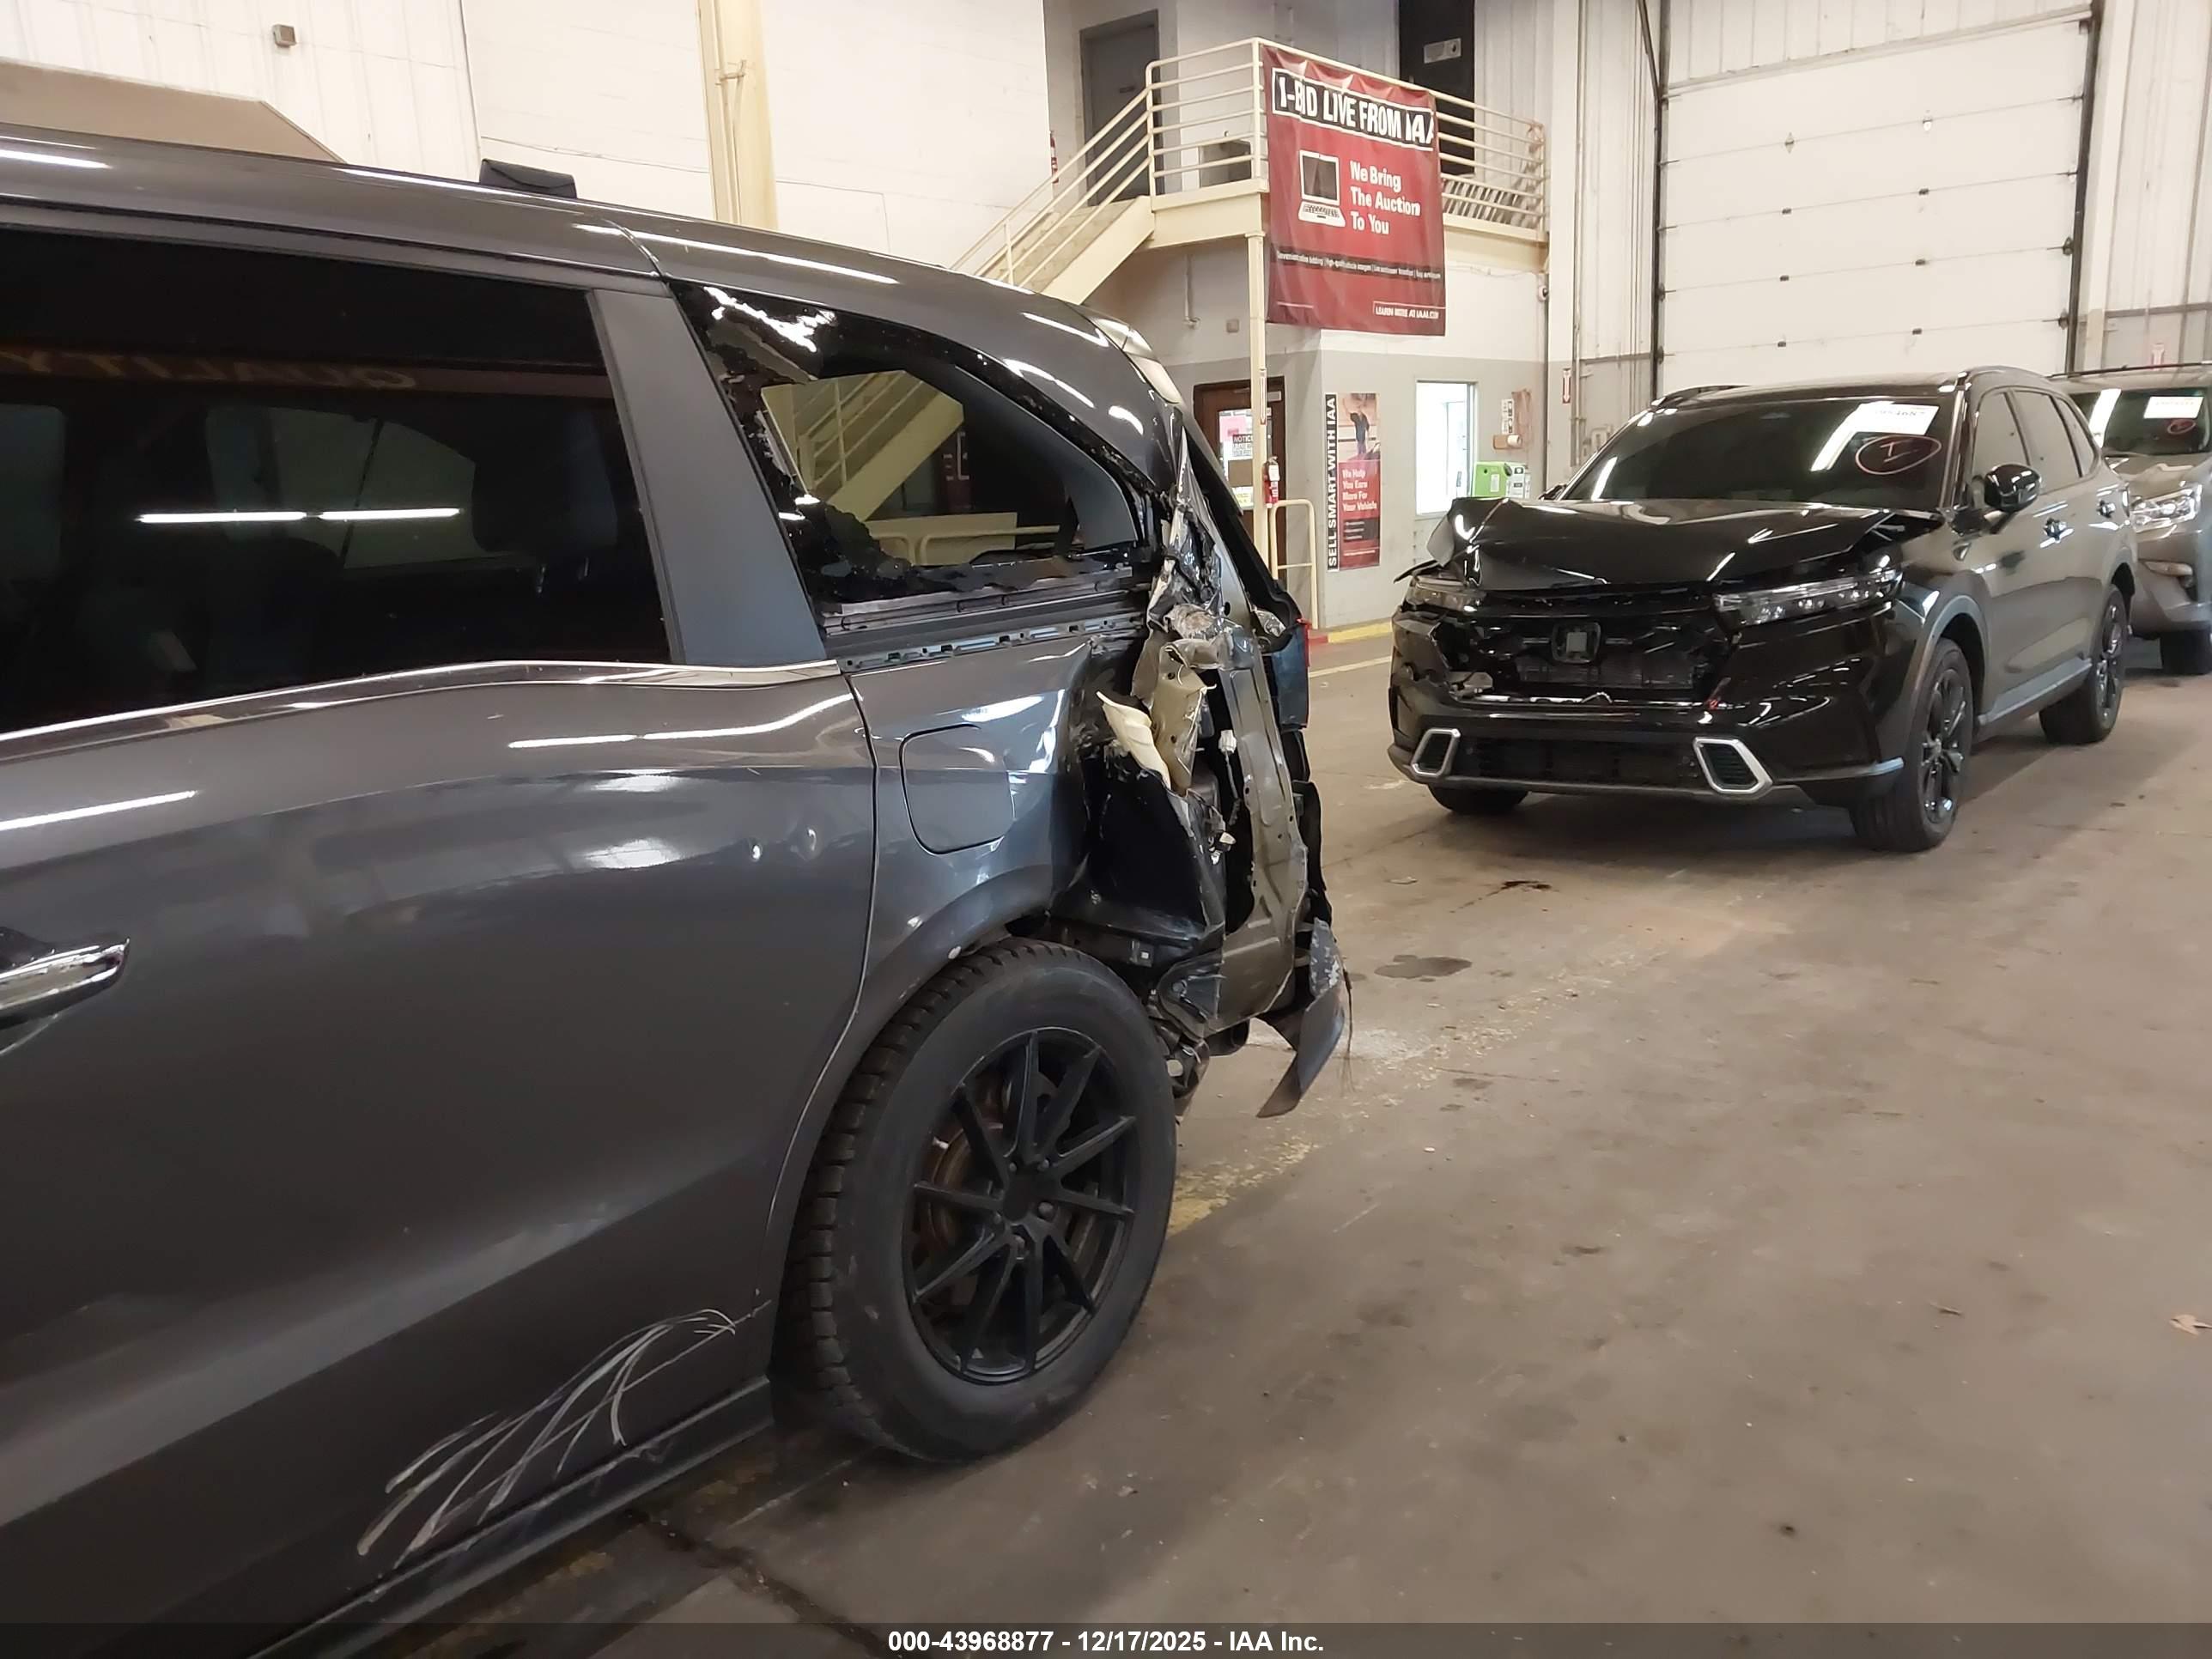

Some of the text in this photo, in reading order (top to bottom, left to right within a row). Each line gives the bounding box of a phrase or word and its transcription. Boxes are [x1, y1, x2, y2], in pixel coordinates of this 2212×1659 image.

[1279, 76, 1317, 117] I-BID
[1323, 89, 1357, 127] LIVE
[1358, 100, 1401, 139] FROM
[1350, 160, 1401, 193] We Bring
[1350, 185, 1420, 216] The Auction
[1350, 210, 1389, 234] To You
[1327, 398, 1337, 567] SELL SMART WITH IAA
